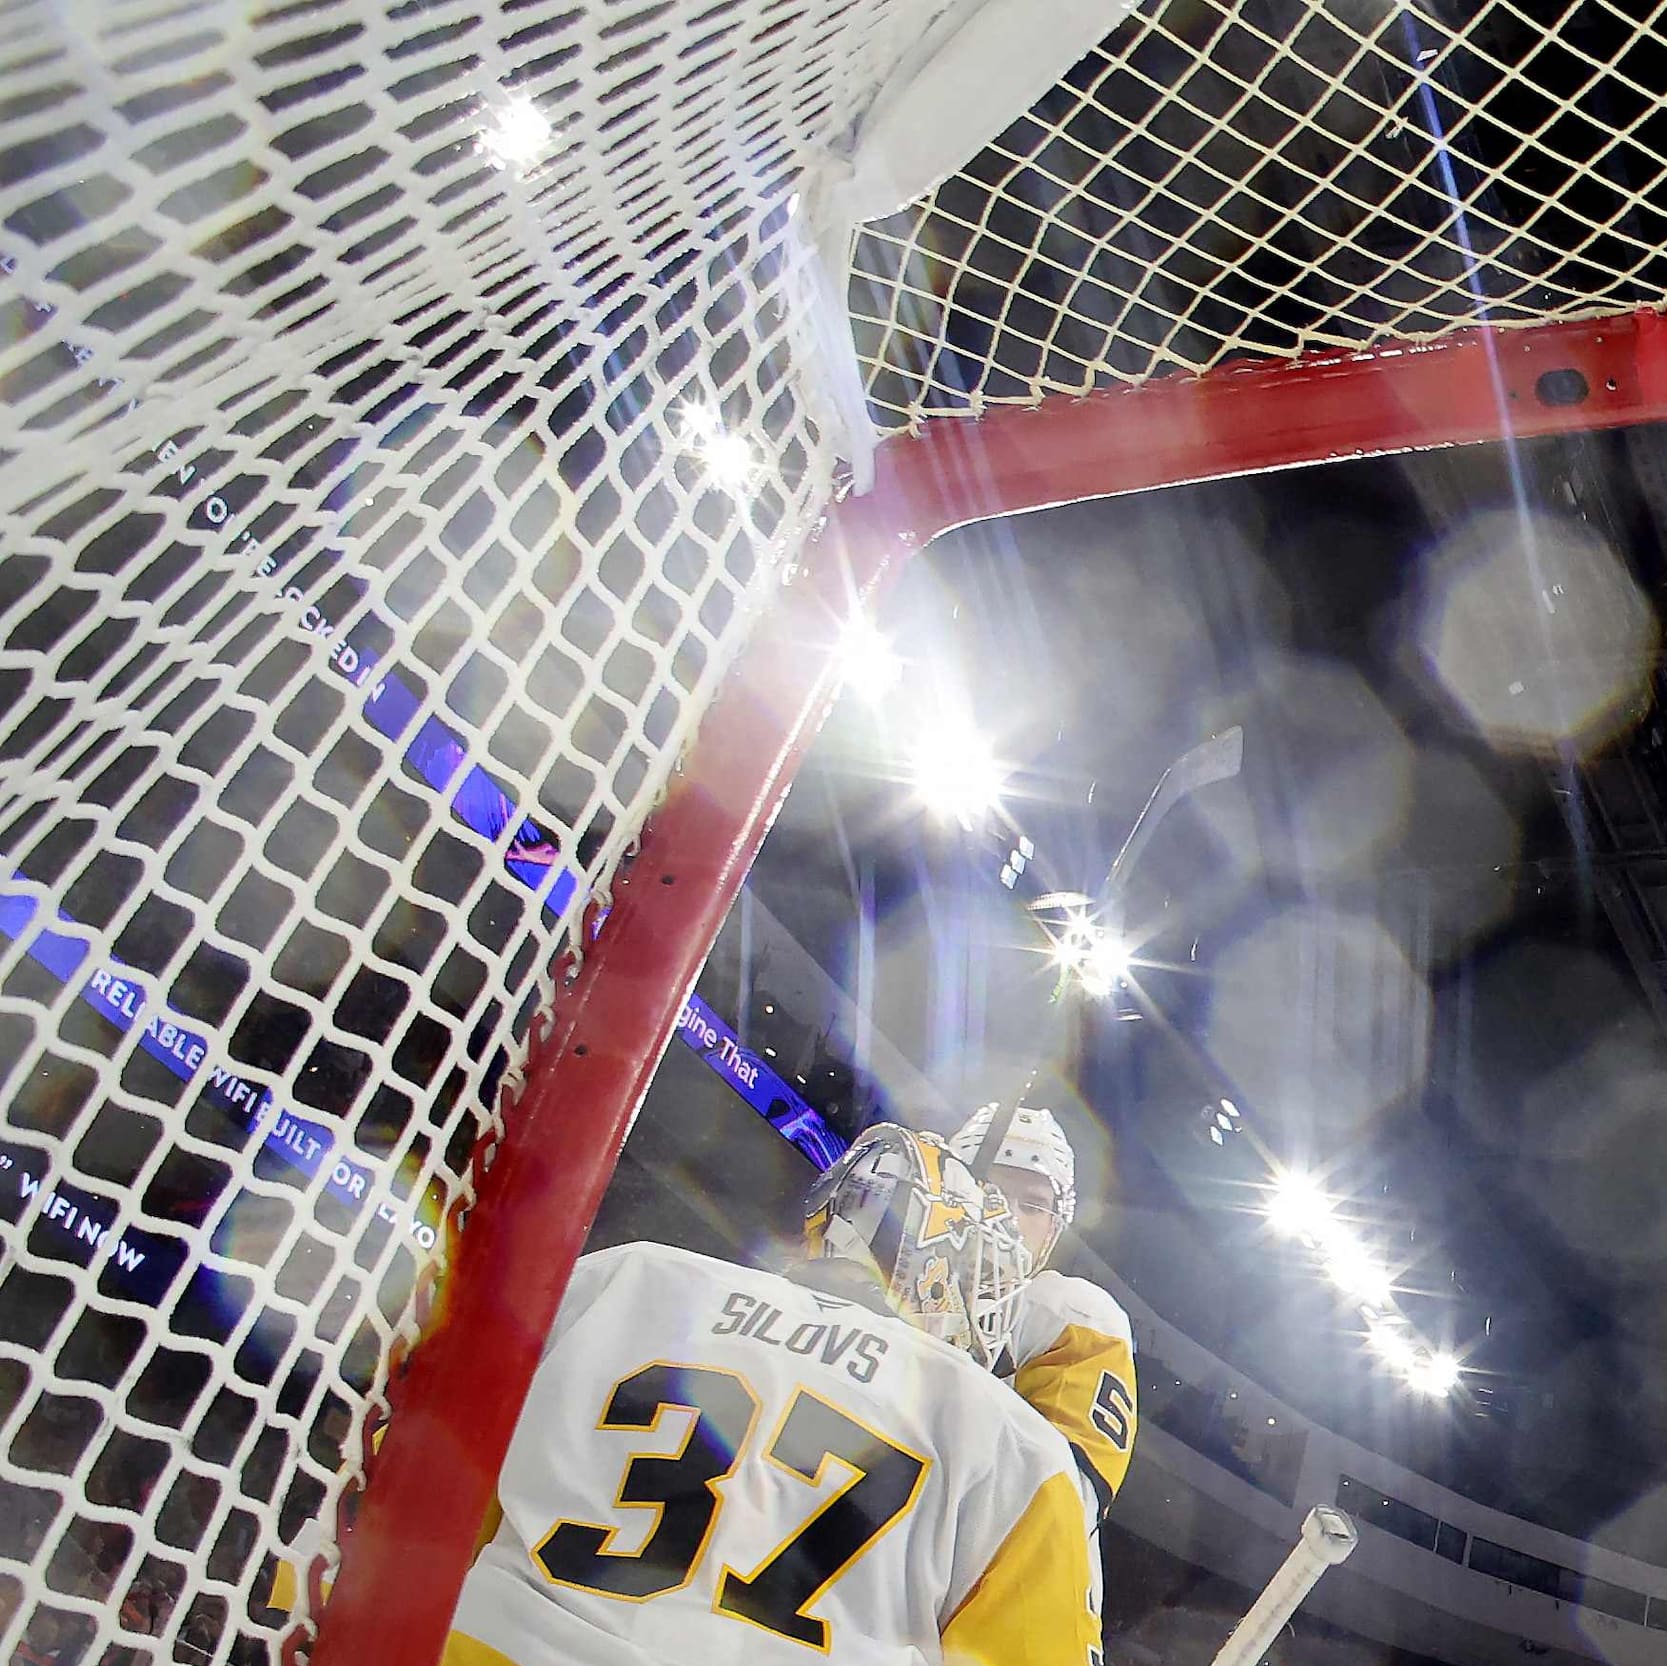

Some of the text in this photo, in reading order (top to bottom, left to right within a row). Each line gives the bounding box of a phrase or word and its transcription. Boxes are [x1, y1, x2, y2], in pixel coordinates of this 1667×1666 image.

[719, 1036, 759, 1089] That
[711, 1291, 889, 1385] SILOVS
[530, 1359, 934, 1656] 37
